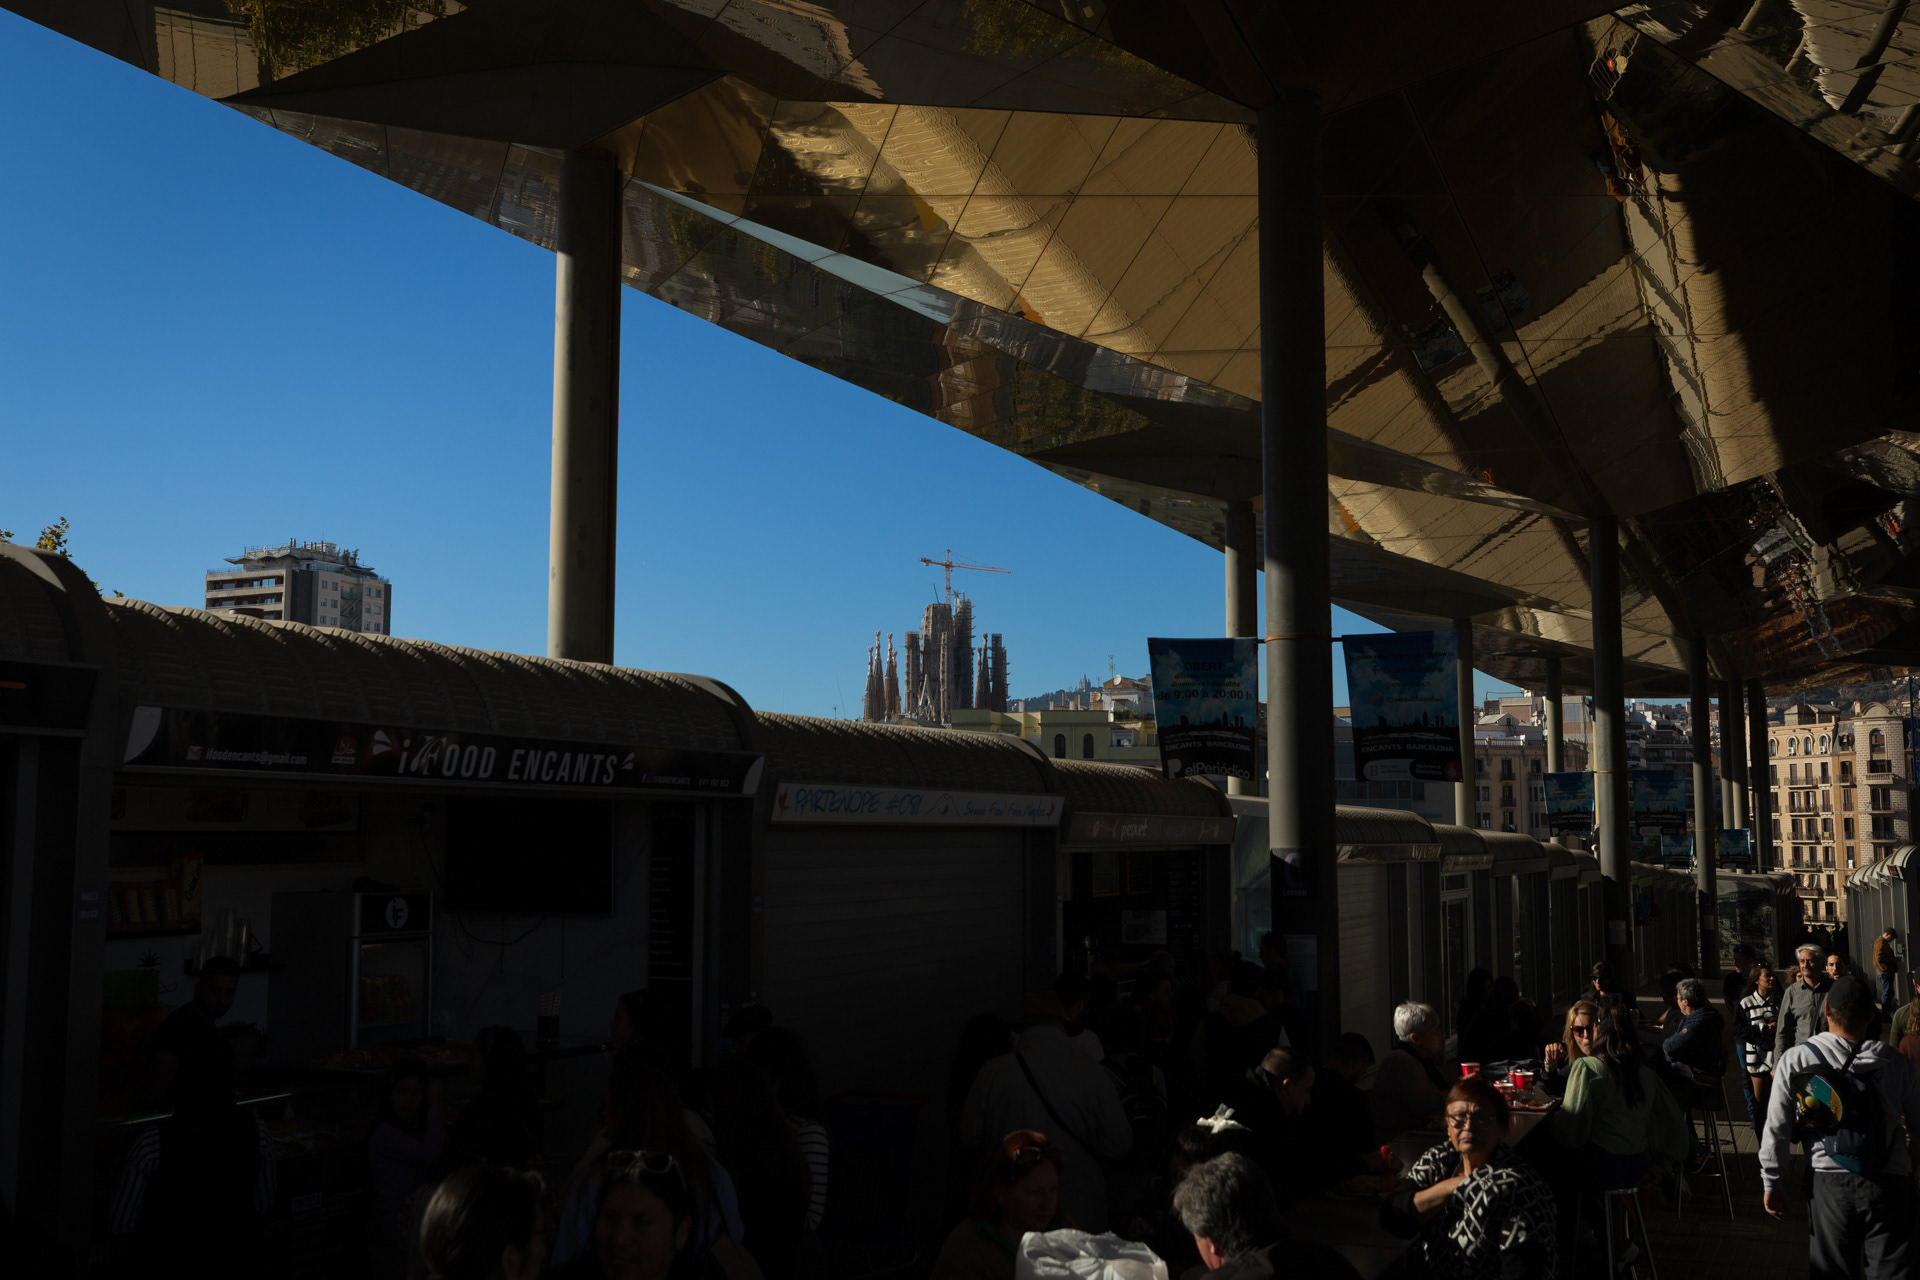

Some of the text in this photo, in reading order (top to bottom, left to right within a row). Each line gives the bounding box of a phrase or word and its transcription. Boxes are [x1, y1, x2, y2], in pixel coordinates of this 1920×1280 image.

[1184, 662, 1224, 671] OBERT
[1157, 691, 1171, 701] de
[1173, 689, 1199, 699] 9:00
[1212, 689, 1244, 699] 20:00
[1165, 741, 1251, 752] ENCANTS BARCELONA
[1361, 743, 1455, 753] ENCANTS BARCELONA
[507, 749, 618, 784] ENCANTS
[1185, 762, 1251, 780] elPeriódico
[794, 788, 881, 814] PARTENOPE
[1121, 817, 1148, 842] peixet
